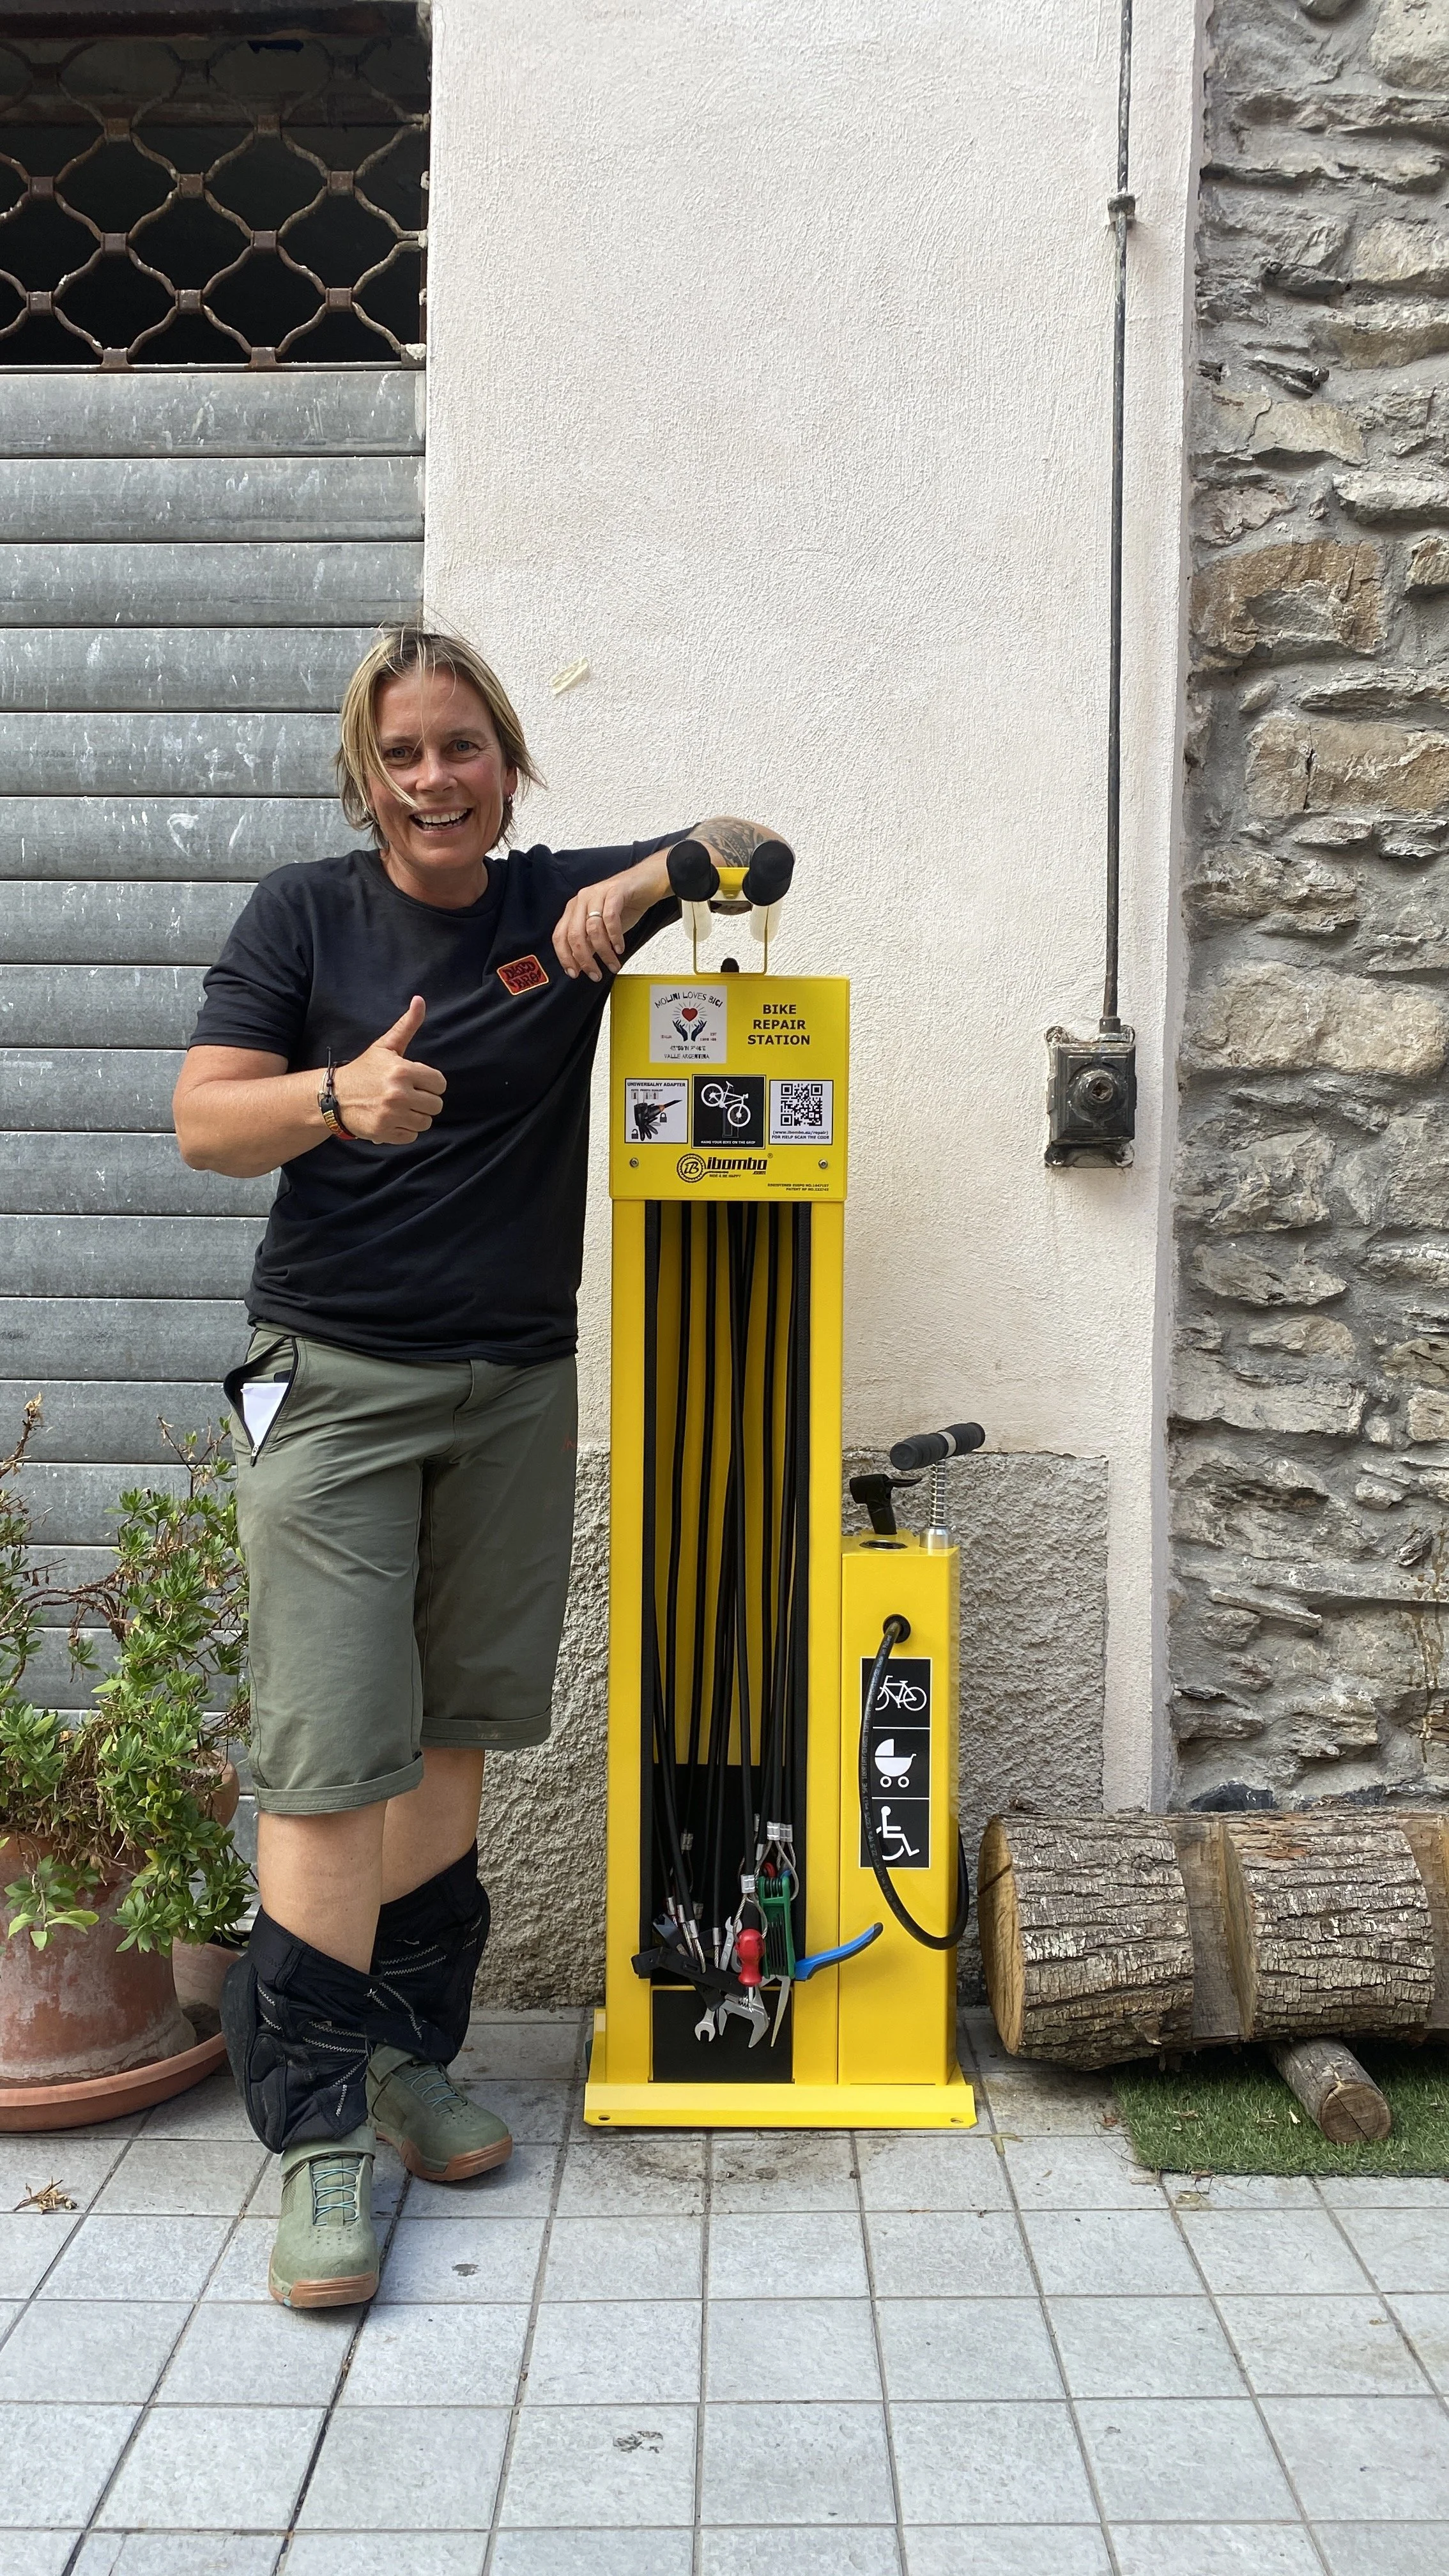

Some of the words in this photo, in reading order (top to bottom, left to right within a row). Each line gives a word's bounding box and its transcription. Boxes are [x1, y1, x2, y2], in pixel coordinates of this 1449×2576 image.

[654, 992, 680, 1009] MOLINI
[682, 991, 707, 1001] LOVES
[708, 995, 723, 1008] BICI
[763, 1004, 797, 1015] BIKE
[753, 1019, 806, 1030] REPAIR
[747, 1034, 810, 1045] STATION
[707, 1156, 768, 1170] ibombo
